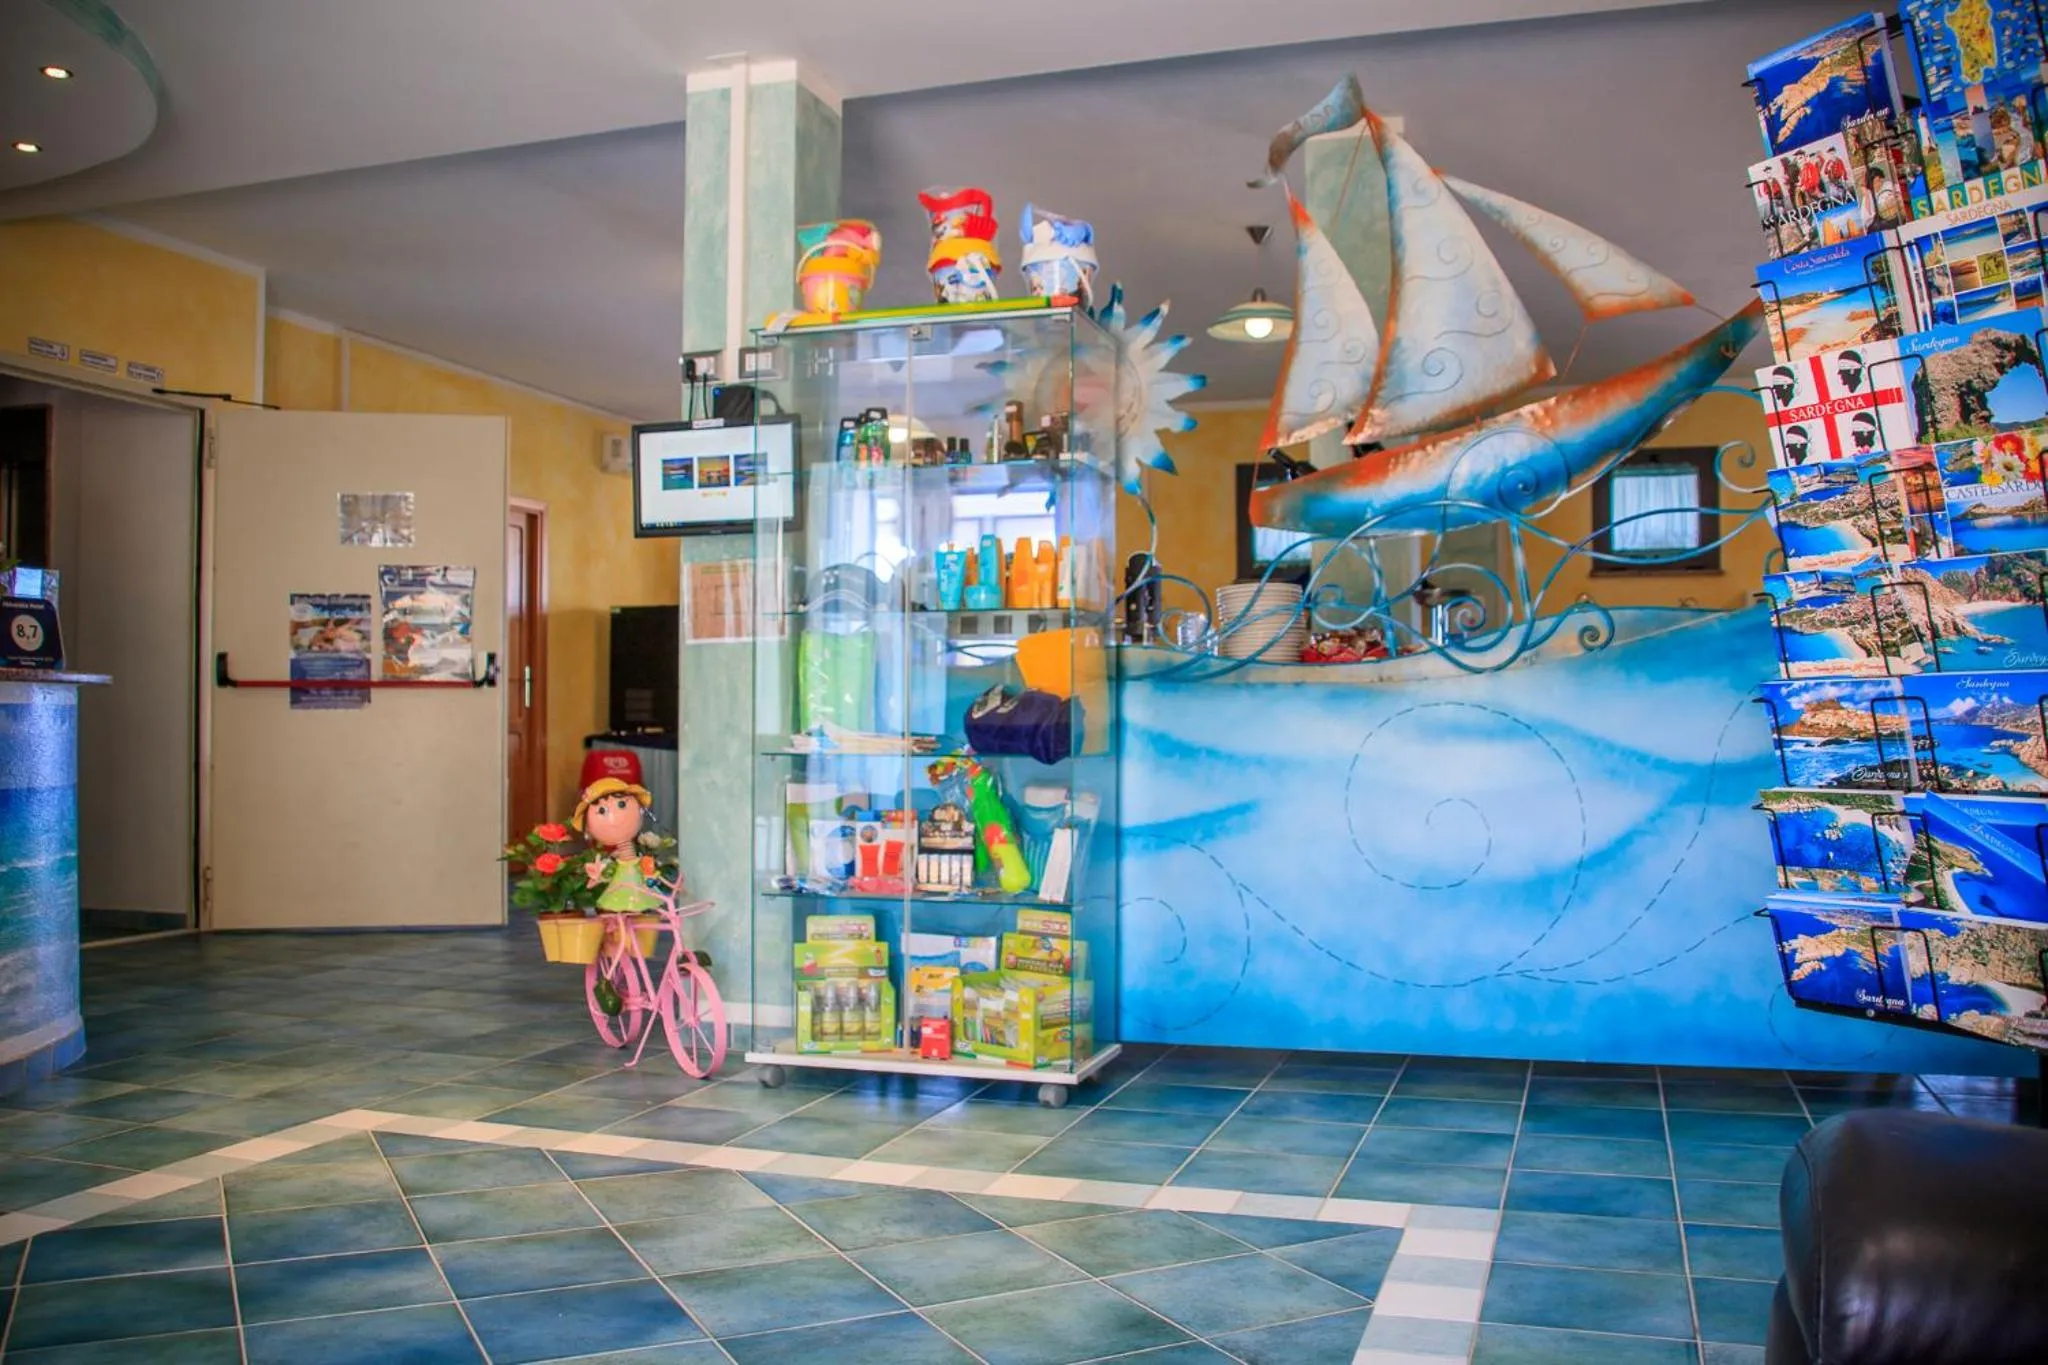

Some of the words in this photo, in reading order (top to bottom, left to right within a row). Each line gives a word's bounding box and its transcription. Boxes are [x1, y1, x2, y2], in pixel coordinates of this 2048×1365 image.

[1788, 396, 1866, 422] SARDEGNA
[15, 623, 38, 640] 8,7
[1855, 988, 1907, 1009] Sardgna
